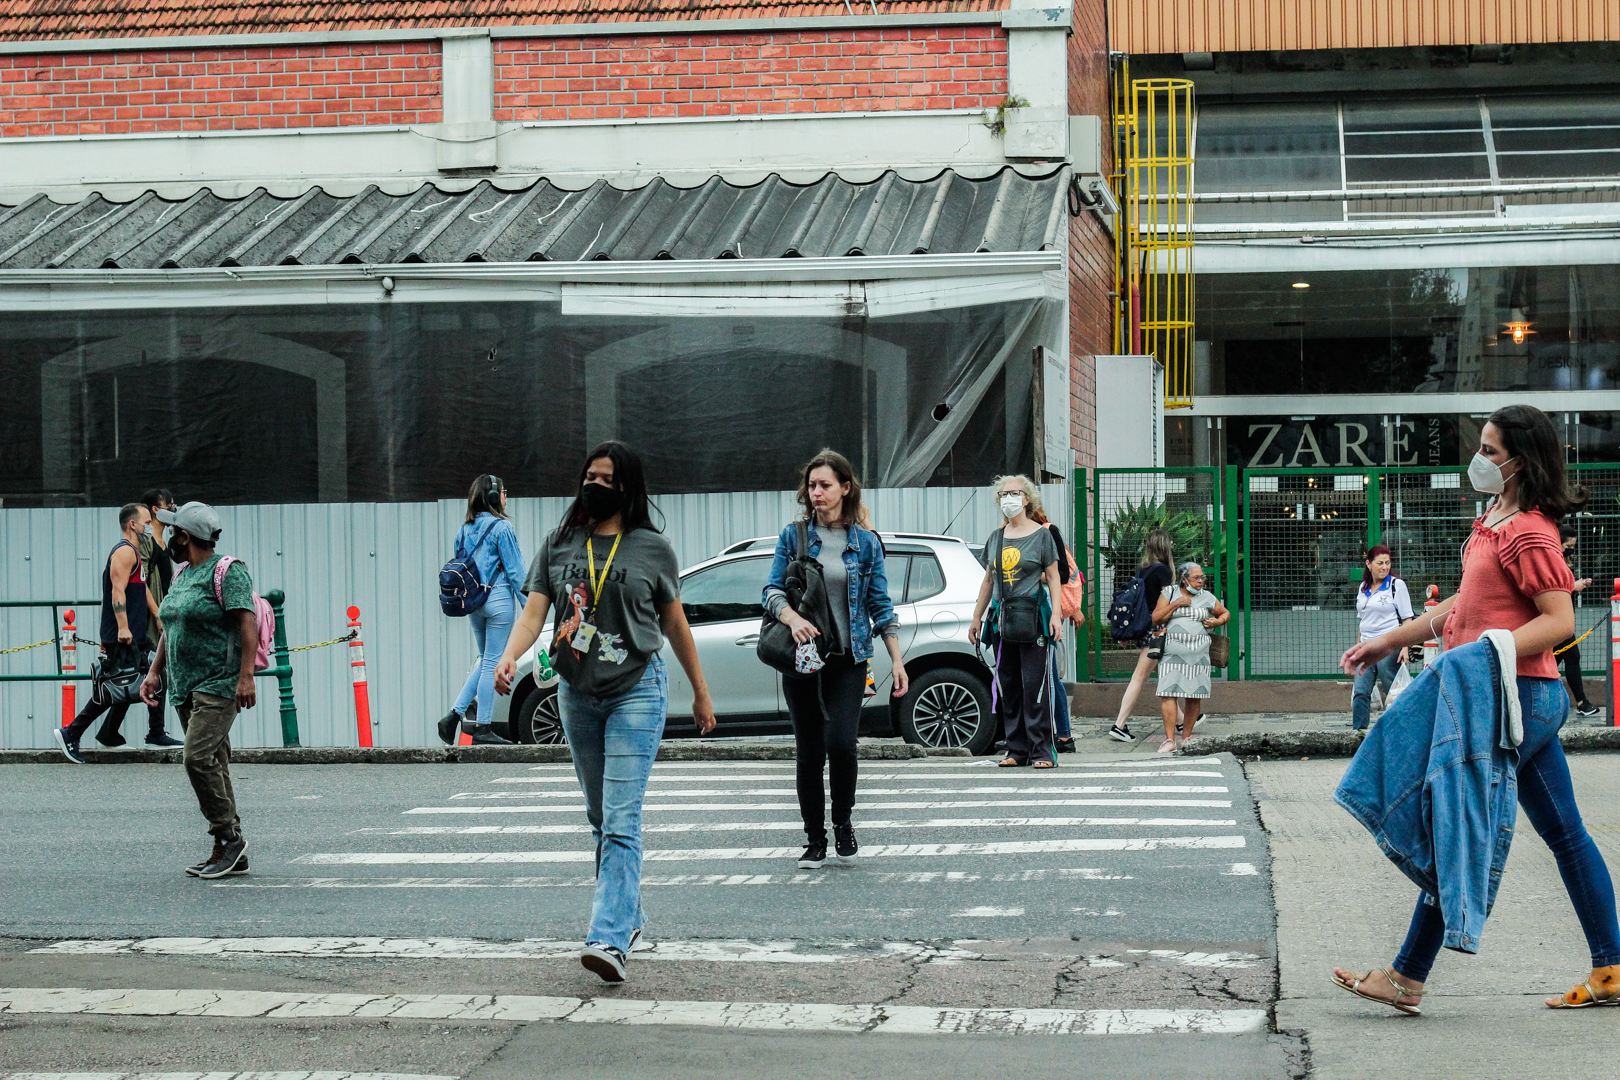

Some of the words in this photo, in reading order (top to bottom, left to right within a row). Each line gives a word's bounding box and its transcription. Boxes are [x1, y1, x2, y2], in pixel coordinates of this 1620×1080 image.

[1247, 421, 1418, 467] ZARE
[1429, 418, 1441, 465] JEANS
[560, 562, 627, 585] Bambi
